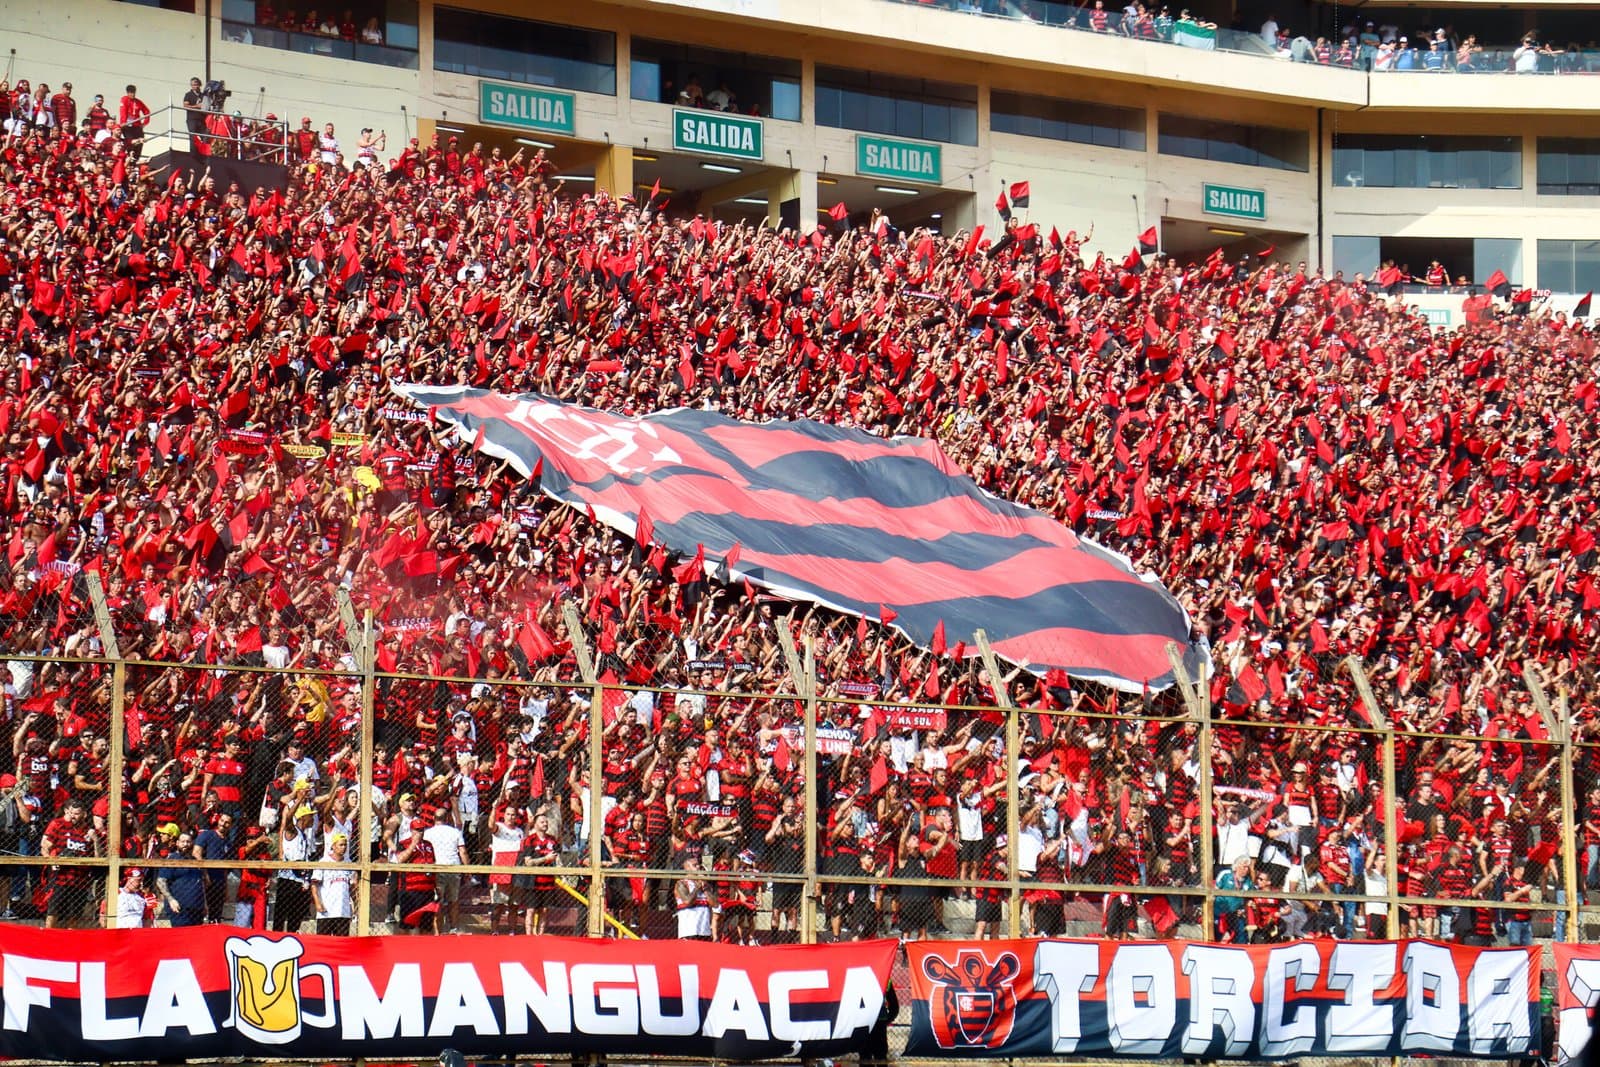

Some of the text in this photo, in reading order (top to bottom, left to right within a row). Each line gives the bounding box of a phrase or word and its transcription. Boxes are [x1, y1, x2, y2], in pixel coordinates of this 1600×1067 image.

[490, 90, 567, 125] SALIDA
[682, 118, 754, 151] SALIDA
[865, 143, 934, 174] SALIDA
[1209, 189, 1261, 213] SALIDA
[386, 462, 394, 475] 7
[913, 716, 932, 727] SUL
[825, 740, 851, 753] UNE
[2, 953, 218, 1041] FLA
[1033, 941, 1531, 1056] TORCIDA
